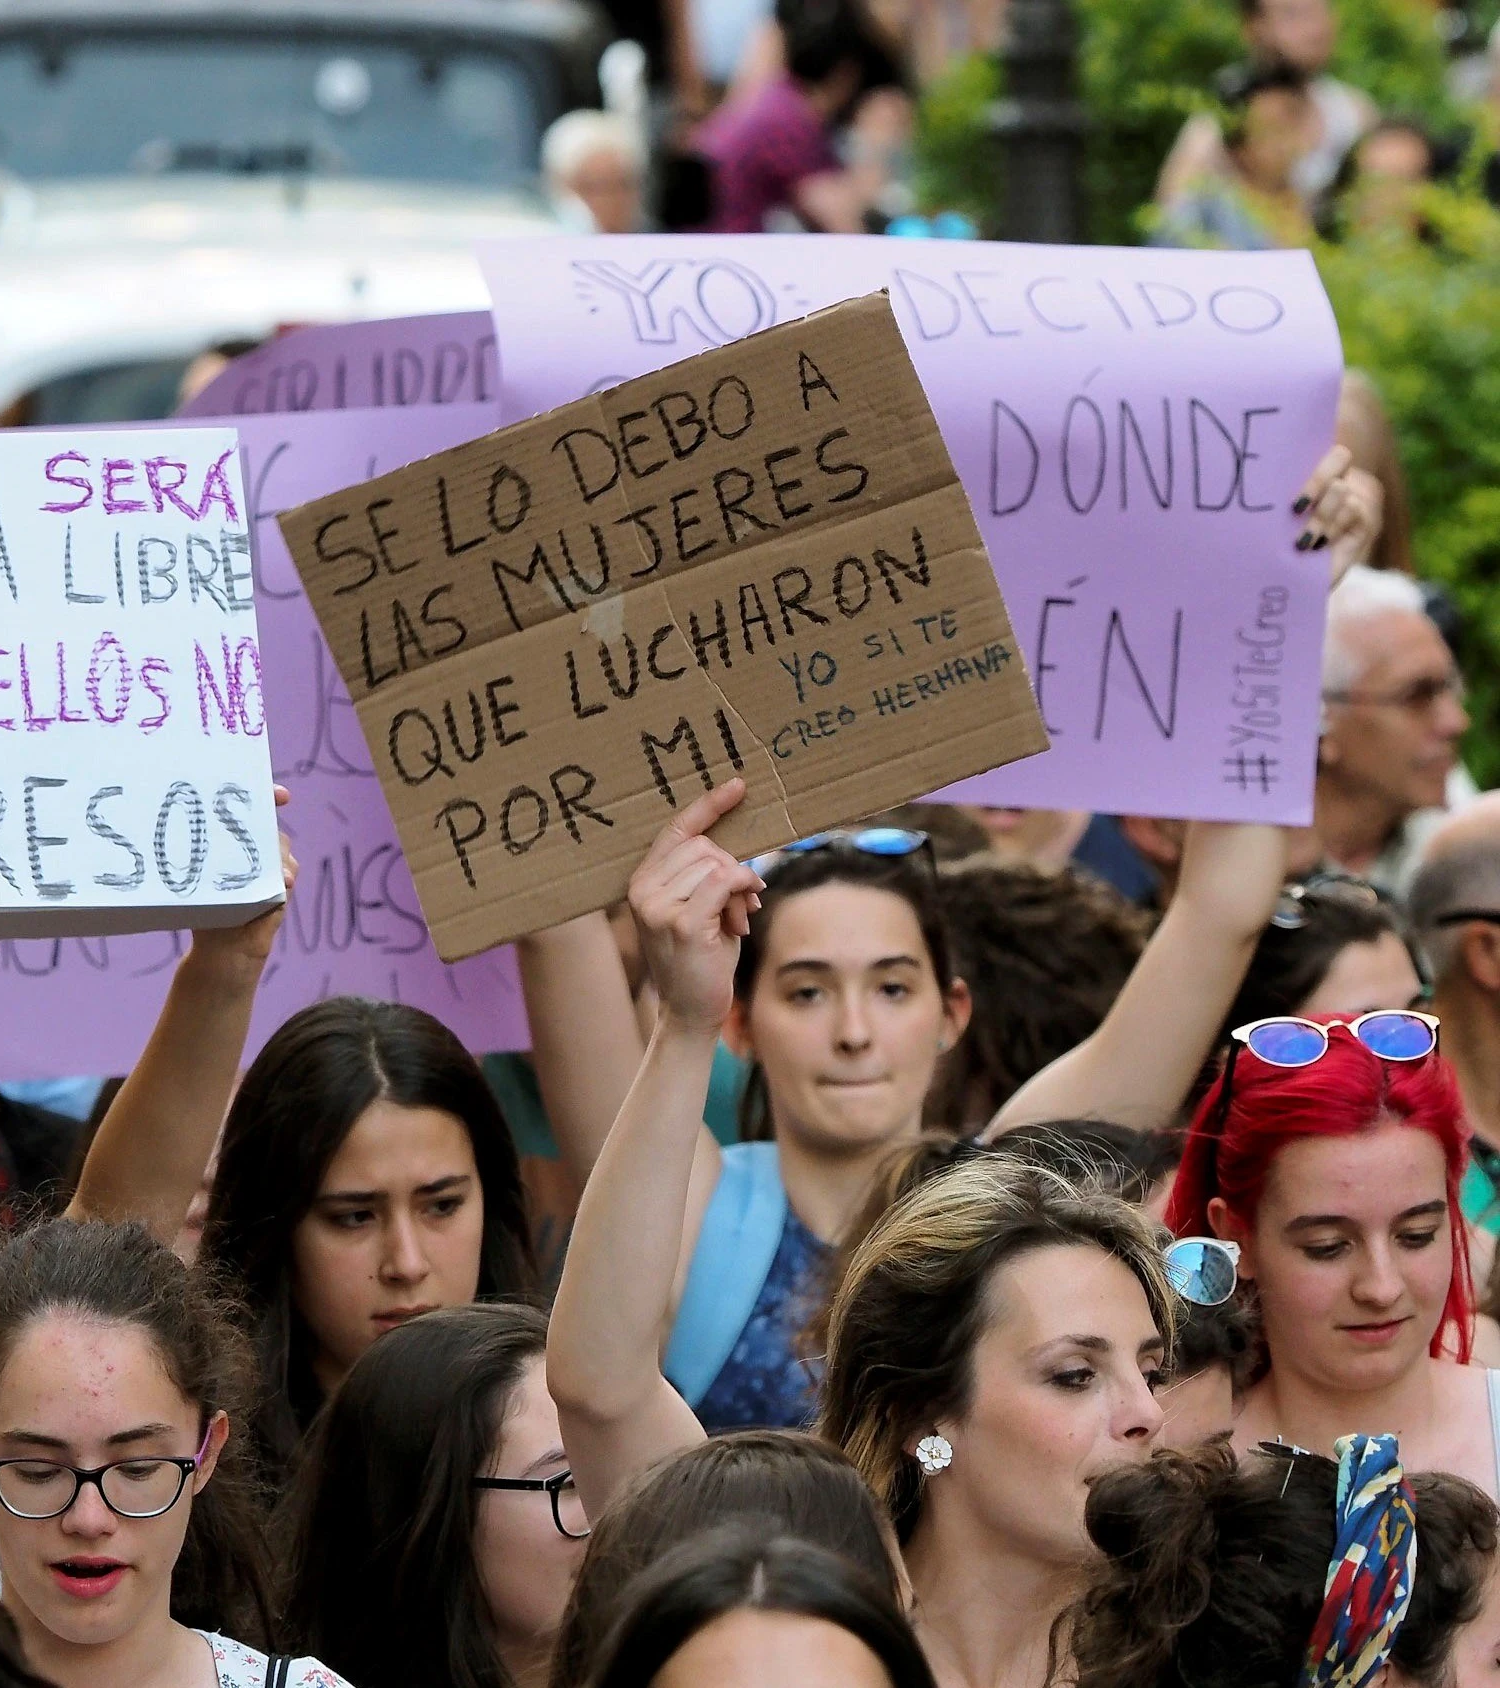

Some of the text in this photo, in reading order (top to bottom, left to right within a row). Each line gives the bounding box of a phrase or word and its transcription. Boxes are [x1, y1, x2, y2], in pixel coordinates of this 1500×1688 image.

[570, 258, 1285, 347] YO DECIDO
[39, 443, 240, 524] SERÁ
[314, 498, 422, 596] SE
[436, 464, 532, 558] LO
[551, 375, 756, 504] DEBO
[799, 350, 840, 412] A
[988, 367, 1282, 518] DÓNDE
[64, 520, 254, 617] LIBRE
[359, 583, 469, 690] LAS
[489, 426, 870, 633] MUJERES
[194, 630, 267, 737] NO
[387, 674, 529, 788] QUE
[564, 526, 931, 721] LUCHARON
[771, 643, 1012, 760] CREO HERMANA
[778, 608, 958, 704] YO SI TE
[433, 706, 746, 891] POR MI
